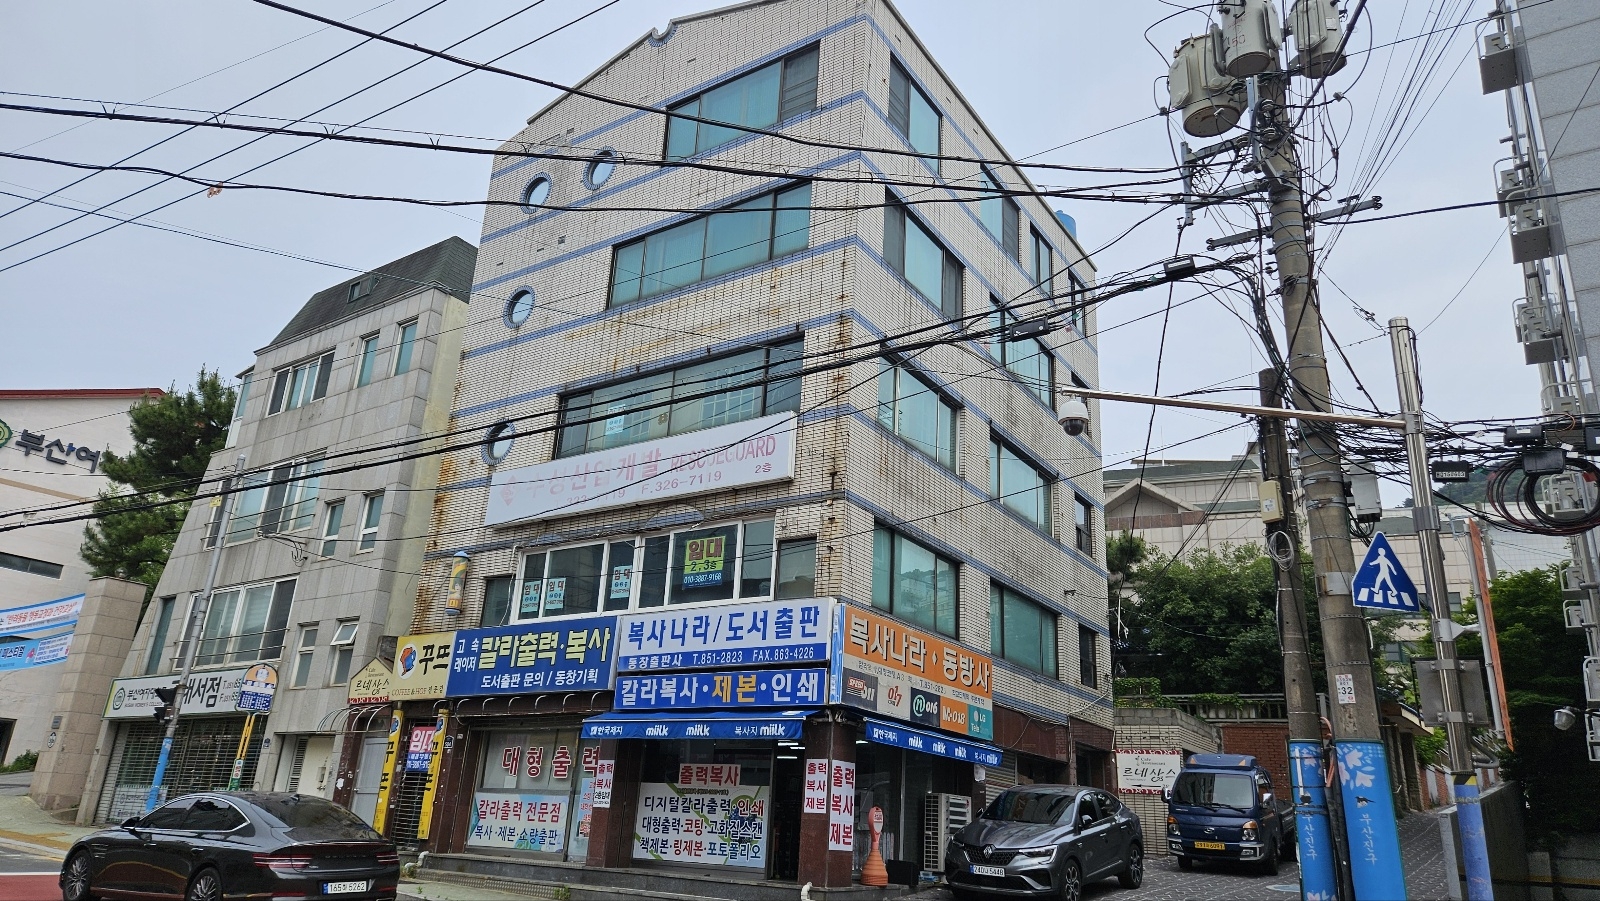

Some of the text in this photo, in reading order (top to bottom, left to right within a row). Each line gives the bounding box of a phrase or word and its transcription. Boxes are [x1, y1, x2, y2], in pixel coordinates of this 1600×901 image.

[15, 429, 100, 473] 부산여
[755, 462, 772, 474] 2층
[688, 537, 723, 561] 임대
[453, 656, 477, 673] 레이저
[628, 653, 683, 669] 동창출판사
[692, 650, 743, 666] T.851-2823
[480, 673, 521, 689] 도서출판
[524, 671, 544, 687] 문의
[554, 668, 598, 686] 동창기획
[942, 647, 991, 694] 동방사
[171, 676, 222, 709] 내서점
[1341, 686, 1353, 695] 32
[979, 713, 987, 723] LG
[734, 725, 758, 736] 복사지
[502, 746, 599, 778] 대형출력
[808, 762, 827, 775] 출력
[680, 765, 739, 786] 출력복사
[806, 779, 826, 792] 복사
[833, 765, 855, 789] 출력
[1122, 767, 1176, 783] 르네상스
[478, 799, 561, 823] 칼라출력 전문점
[805, 797, 825, 810] 제본
[832, 794, 853, 816] 복사
[830, 823, 853, 845] 제본
[1359, 813, 1378, 866] 부산진구
[348, 882, 365, 891] 5262
